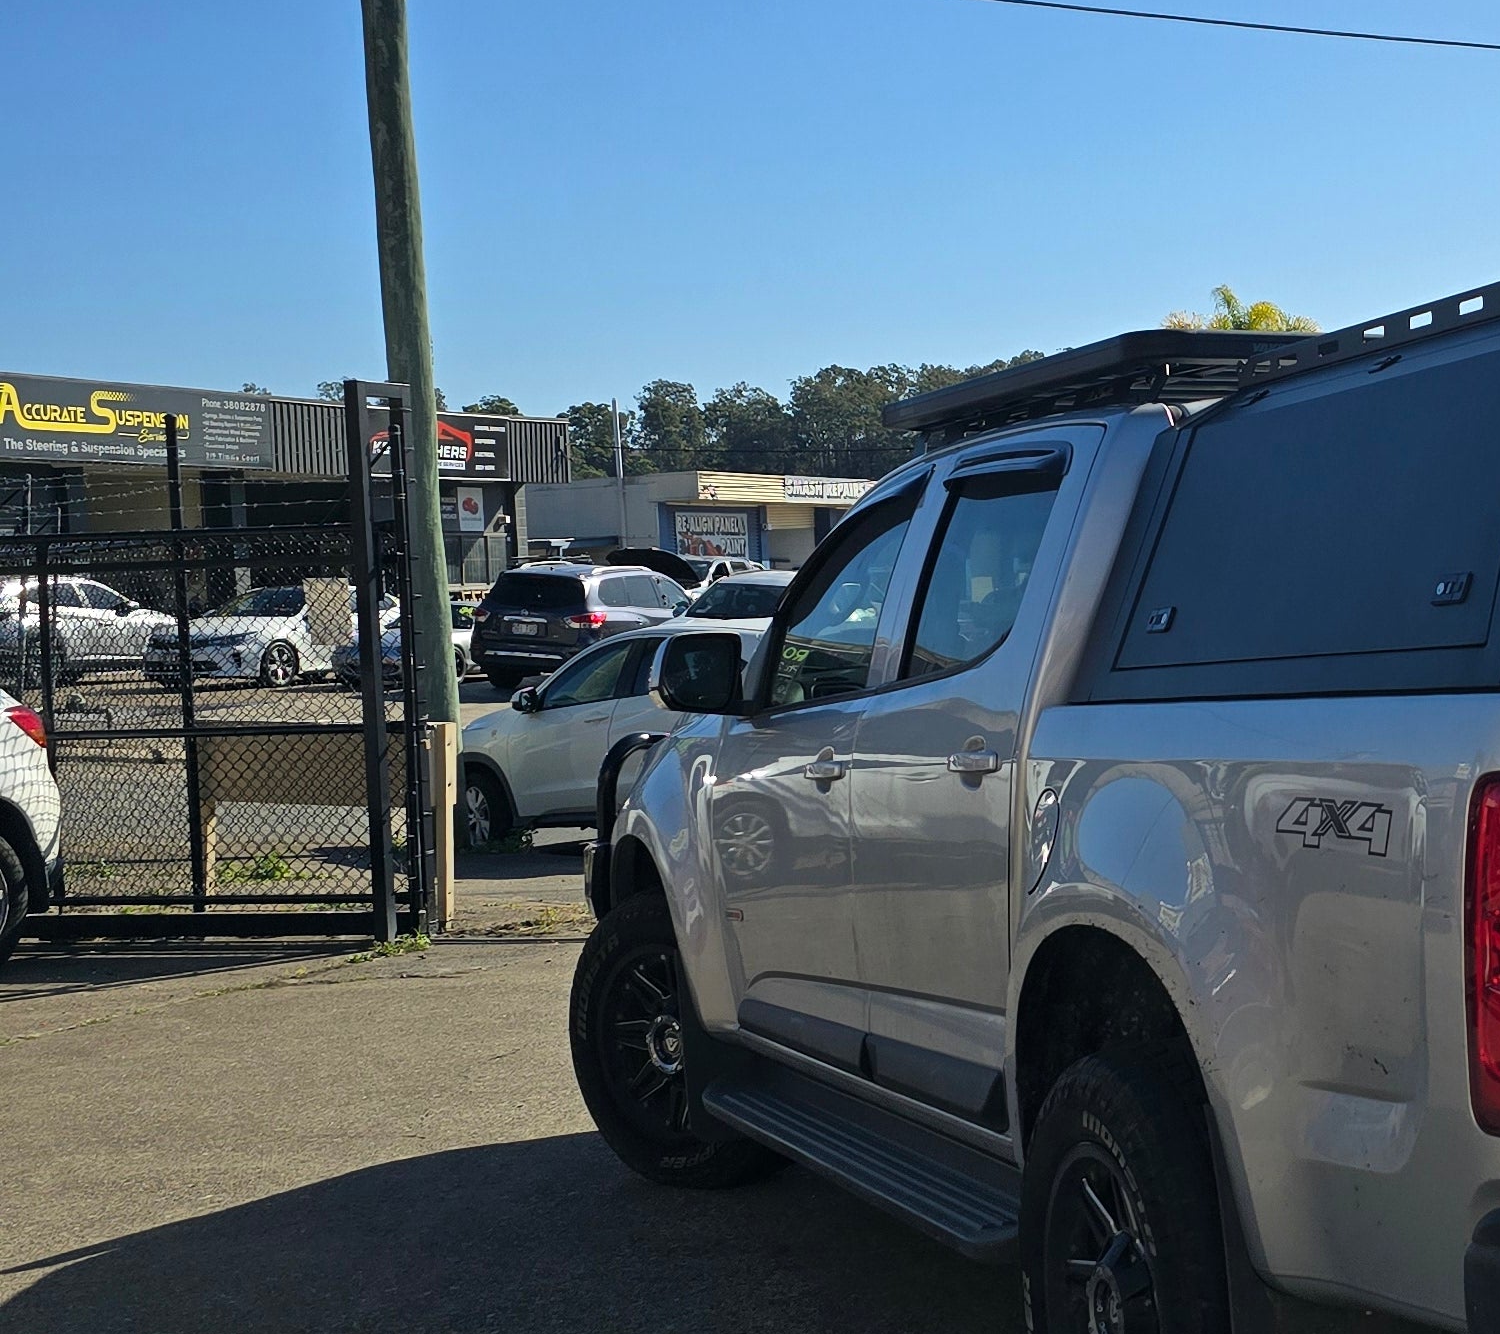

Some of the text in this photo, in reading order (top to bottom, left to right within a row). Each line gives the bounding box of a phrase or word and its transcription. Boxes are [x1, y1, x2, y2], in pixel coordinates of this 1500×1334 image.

[0, 383, 87, 431] ACCURATE
[223, 400, 266, 413] 38082878
[4, 437, 24, 451] The
[26, 438, 69, 456] Steering
[71, 441, 79, 453] &
[81, 442, 135, 457] Suspension
[437, 444, 468, 459] HERS
[786, 478, 824, 498] SMASH
[714, 515, 740, 535] PANEL
[720, 537, 747, 557] PAINT
